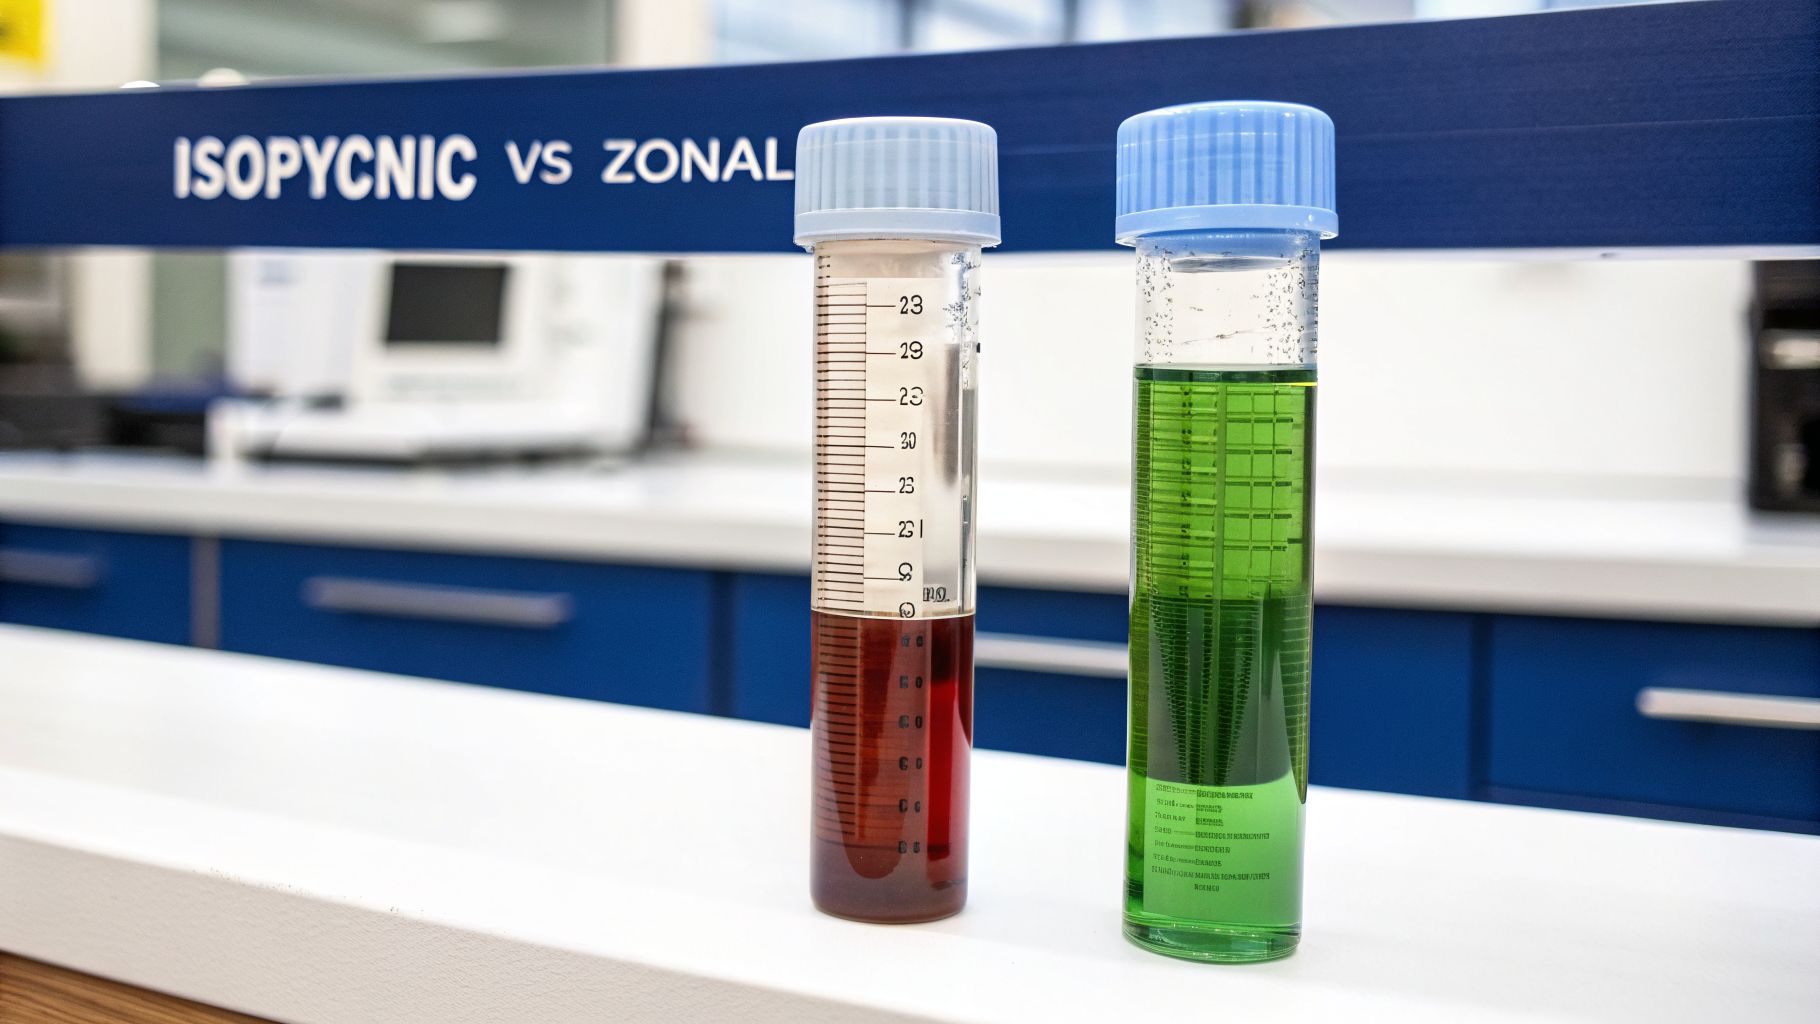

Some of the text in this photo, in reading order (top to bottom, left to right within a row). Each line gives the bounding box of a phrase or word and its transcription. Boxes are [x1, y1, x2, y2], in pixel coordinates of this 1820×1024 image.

[173, 134, 795, 200] ISOPYCNIC VS ZONAL
[900, 294, 924, 315] 23
